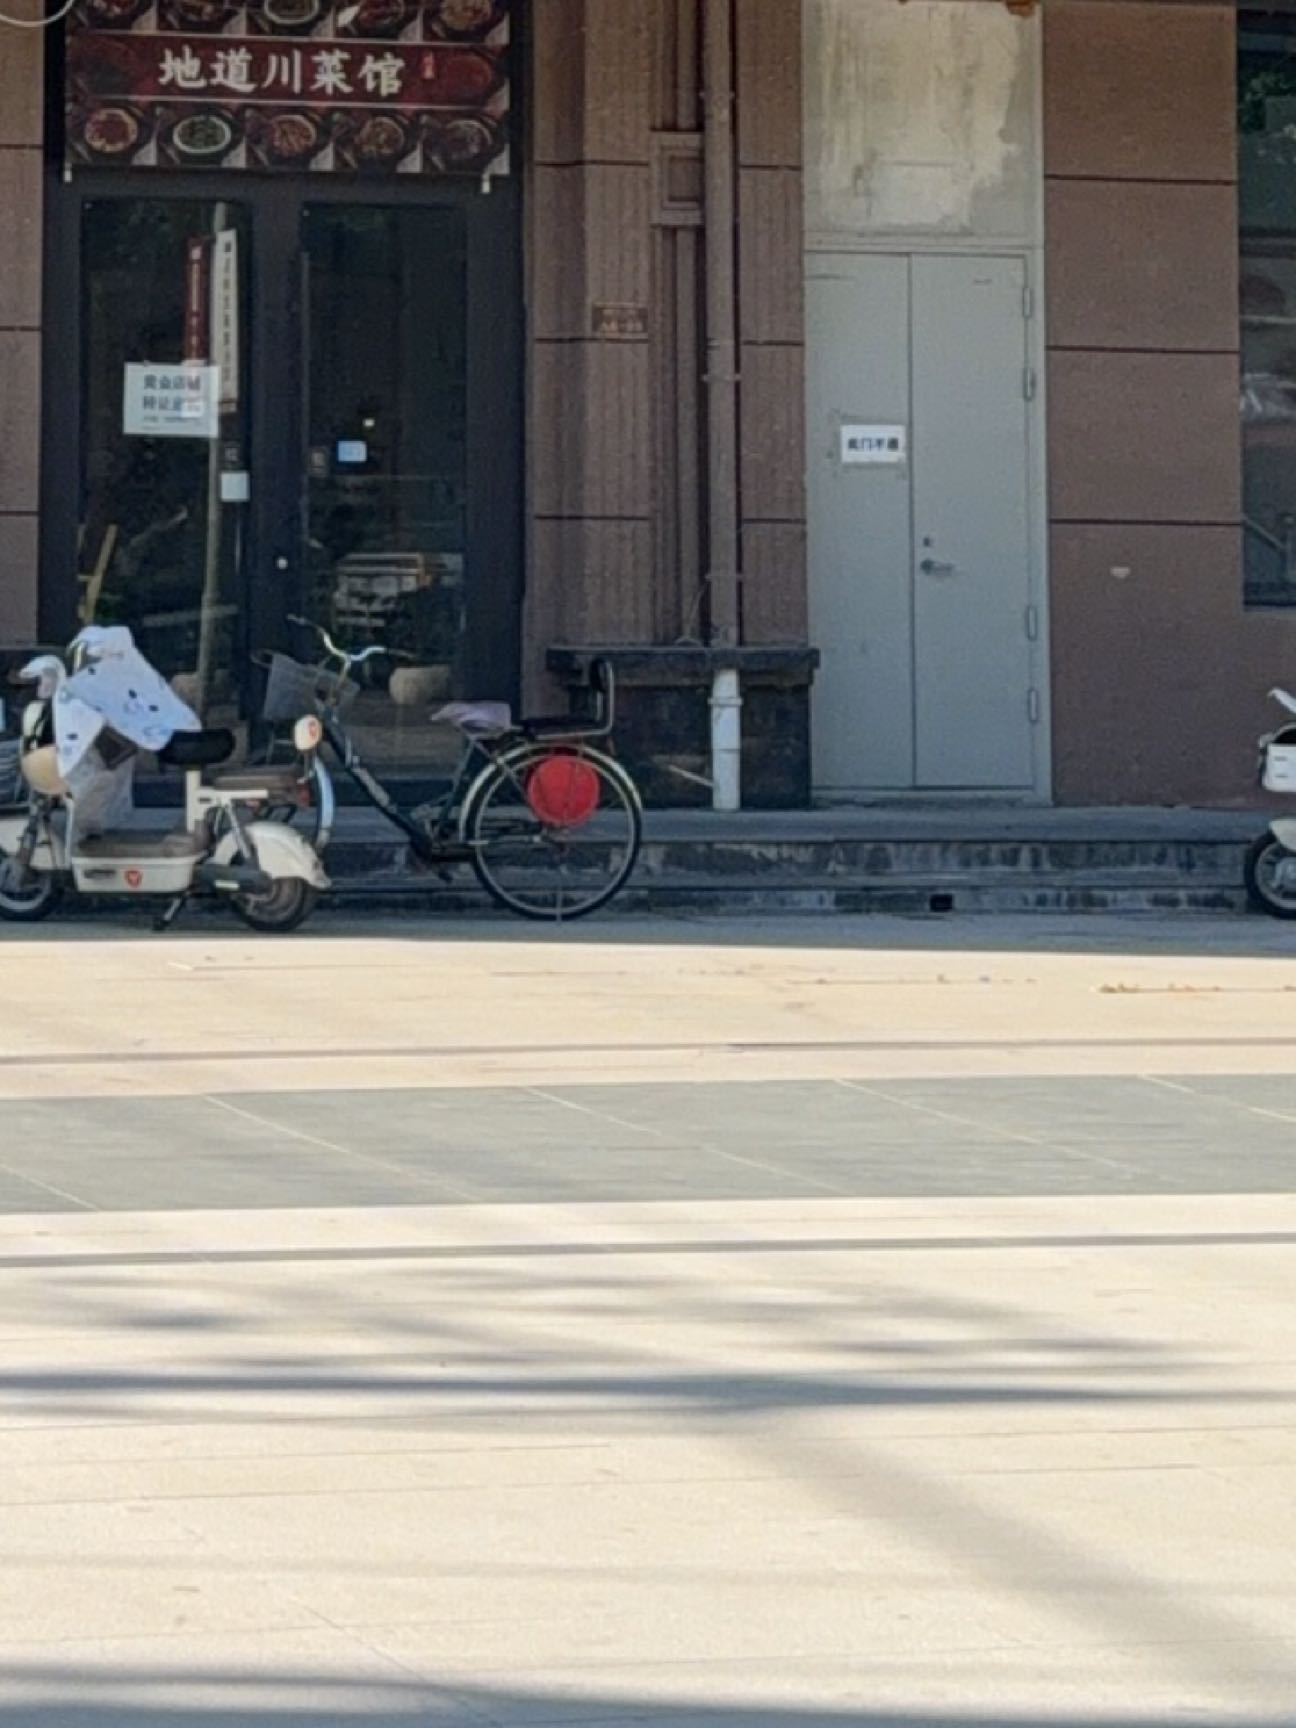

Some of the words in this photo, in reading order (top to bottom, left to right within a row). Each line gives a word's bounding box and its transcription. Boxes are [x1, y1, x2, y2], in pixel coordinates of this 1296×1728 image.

[157, 47, 406, 98] 地道川菜馆
